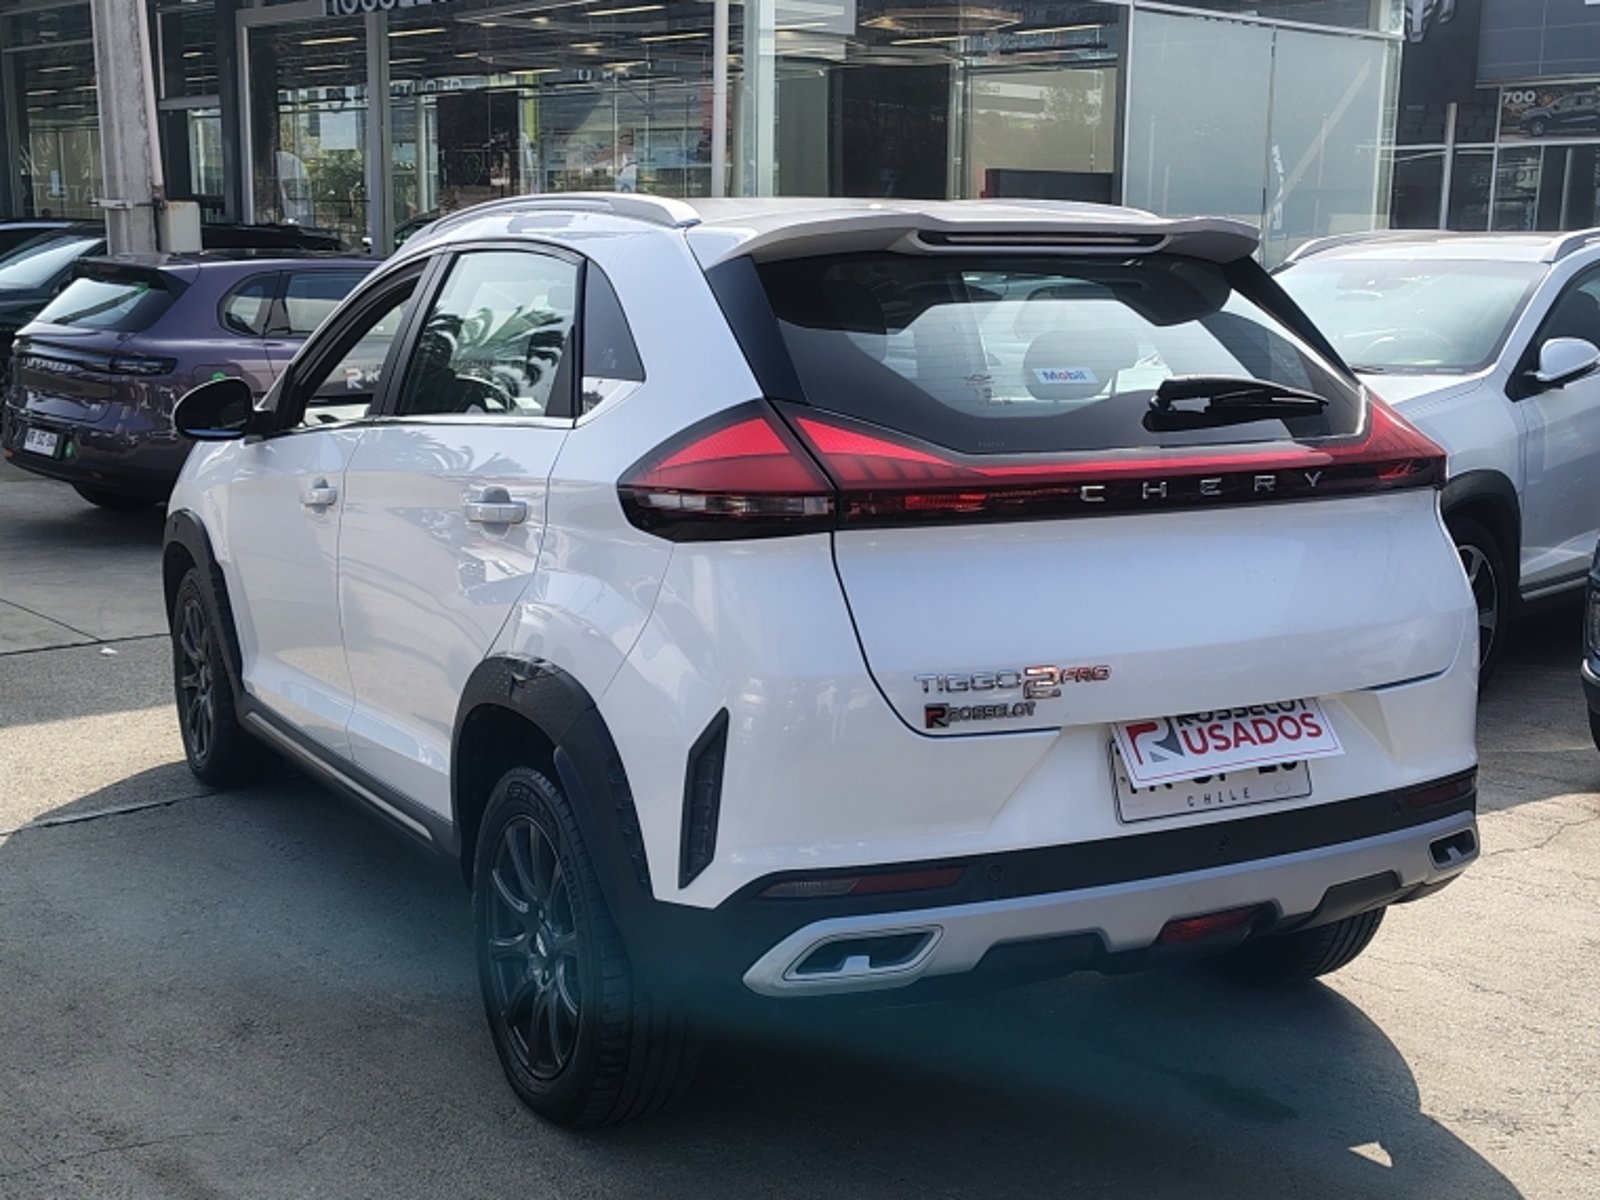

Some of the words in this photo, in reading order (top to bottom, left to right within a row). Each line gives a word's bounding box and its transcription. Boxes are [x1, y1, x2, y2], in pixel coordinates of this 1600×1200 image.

[1080, 471, 1322, 501] CHERY
[913, 669, 1022, 694] TIGGO
[1023, 665, 1062, 699] 2
[1060, 665, 1112, 684] PRO
[1181, 713, 1323, 755] USADOS
[1187, 787, 1251, 807] CHILE
